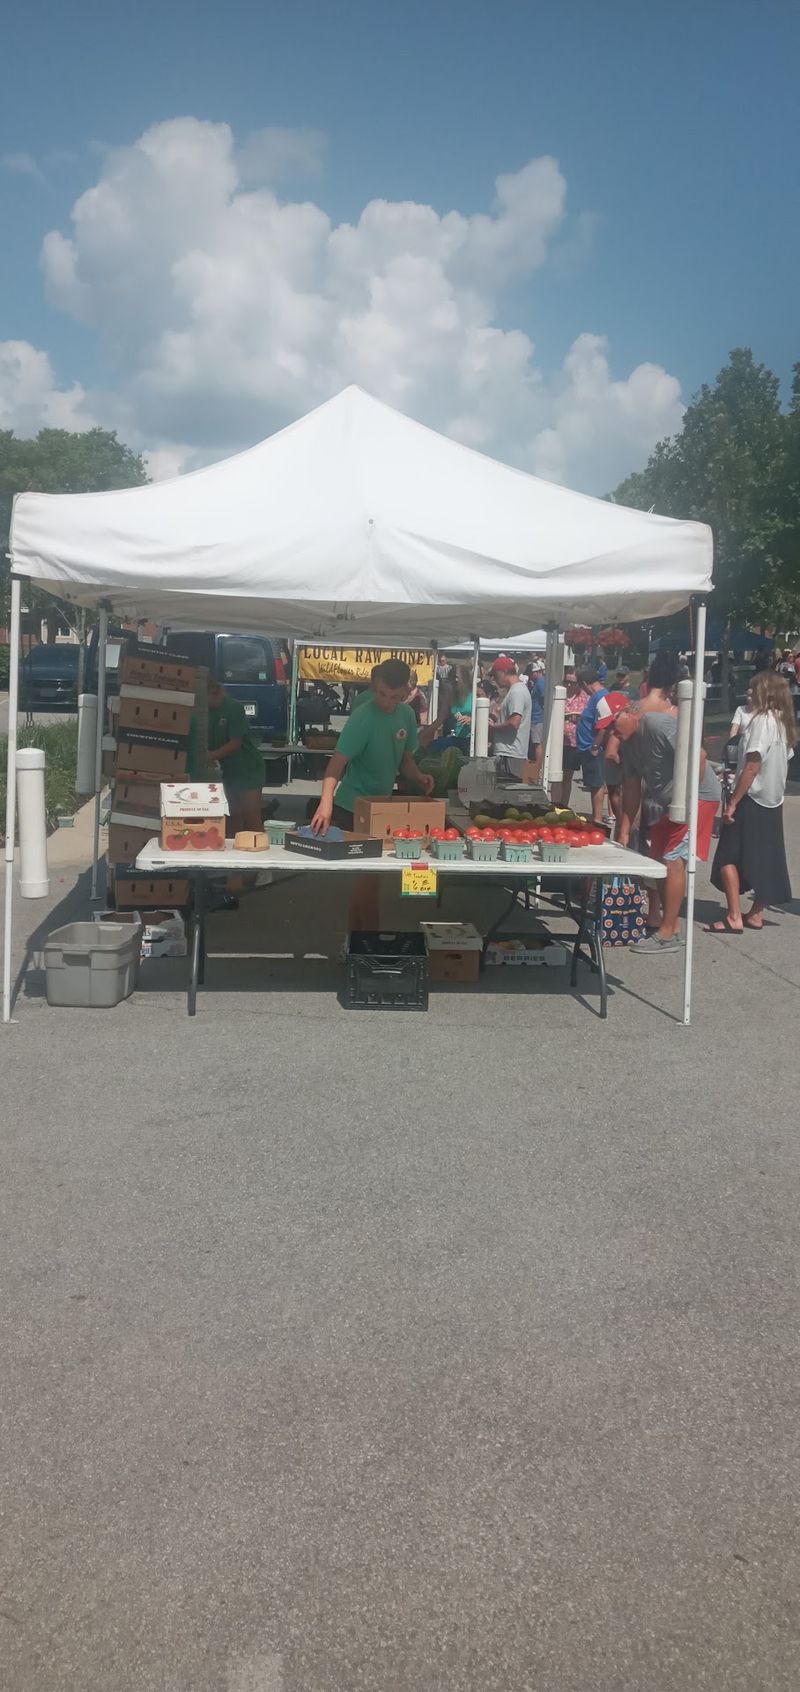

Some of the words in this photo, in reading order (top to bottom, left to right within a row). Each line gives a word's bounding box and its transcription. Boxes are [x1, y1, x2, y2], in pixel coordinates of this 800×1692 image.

[303, 646, 347, 662] LOCAL
[355, 649, 382, 664] RAW
[390, 649, 433, 666] HONEY
[126, 733, 157, 741] COUNTRY
